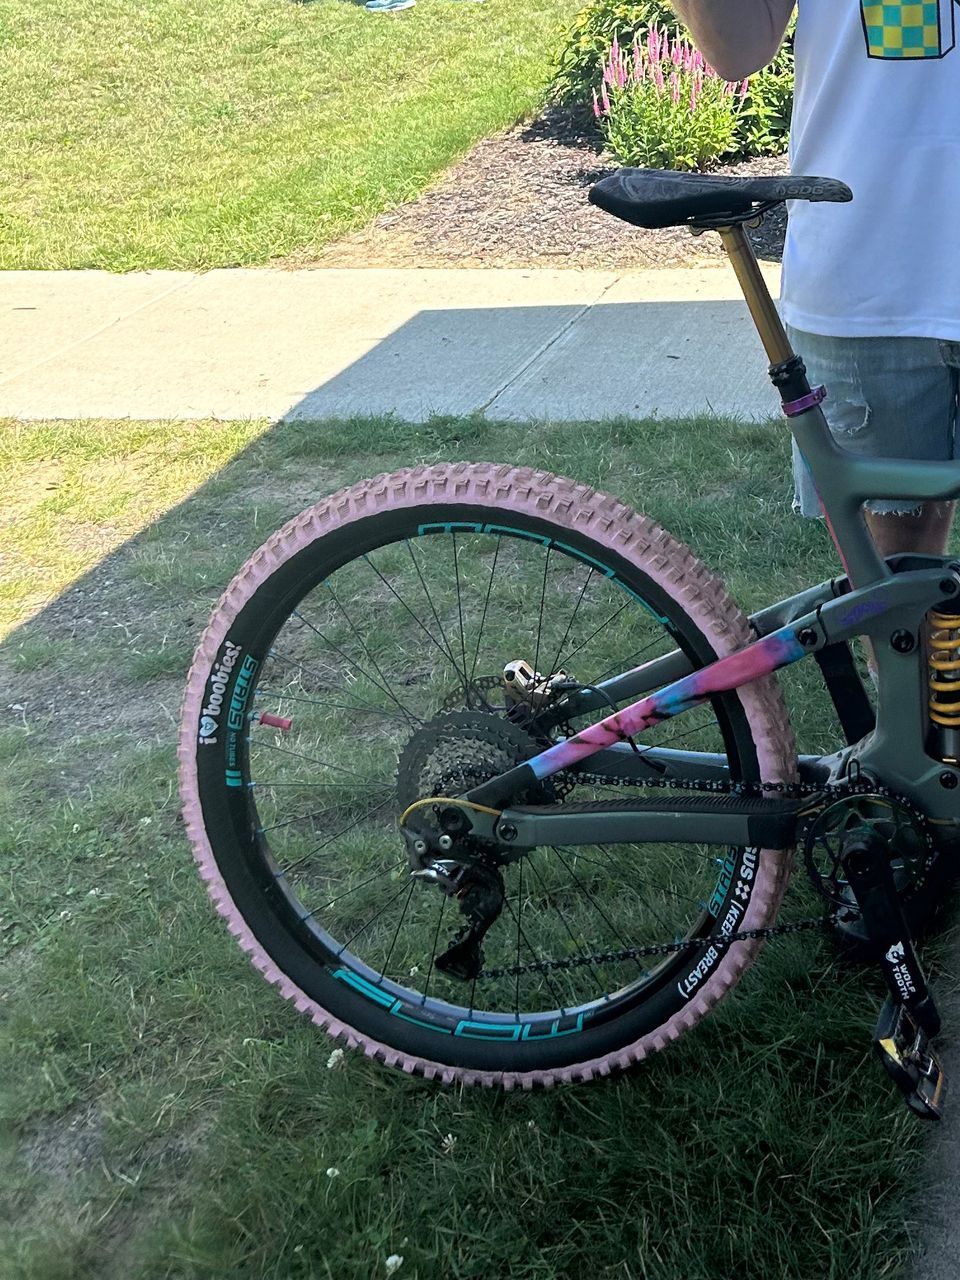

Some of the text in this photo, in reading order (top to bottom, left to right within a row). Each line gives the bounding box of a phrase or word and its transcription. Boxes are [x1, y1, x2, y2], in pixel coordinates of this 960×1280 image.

[788, 184, 824, 196] SDG
[202, 640, 243, 717] boobies!
[677, 945, 719, 999] BREAST)
[892, 965, 910, 1000] TOOTH
[900, 963, 917, 993] WOLF
